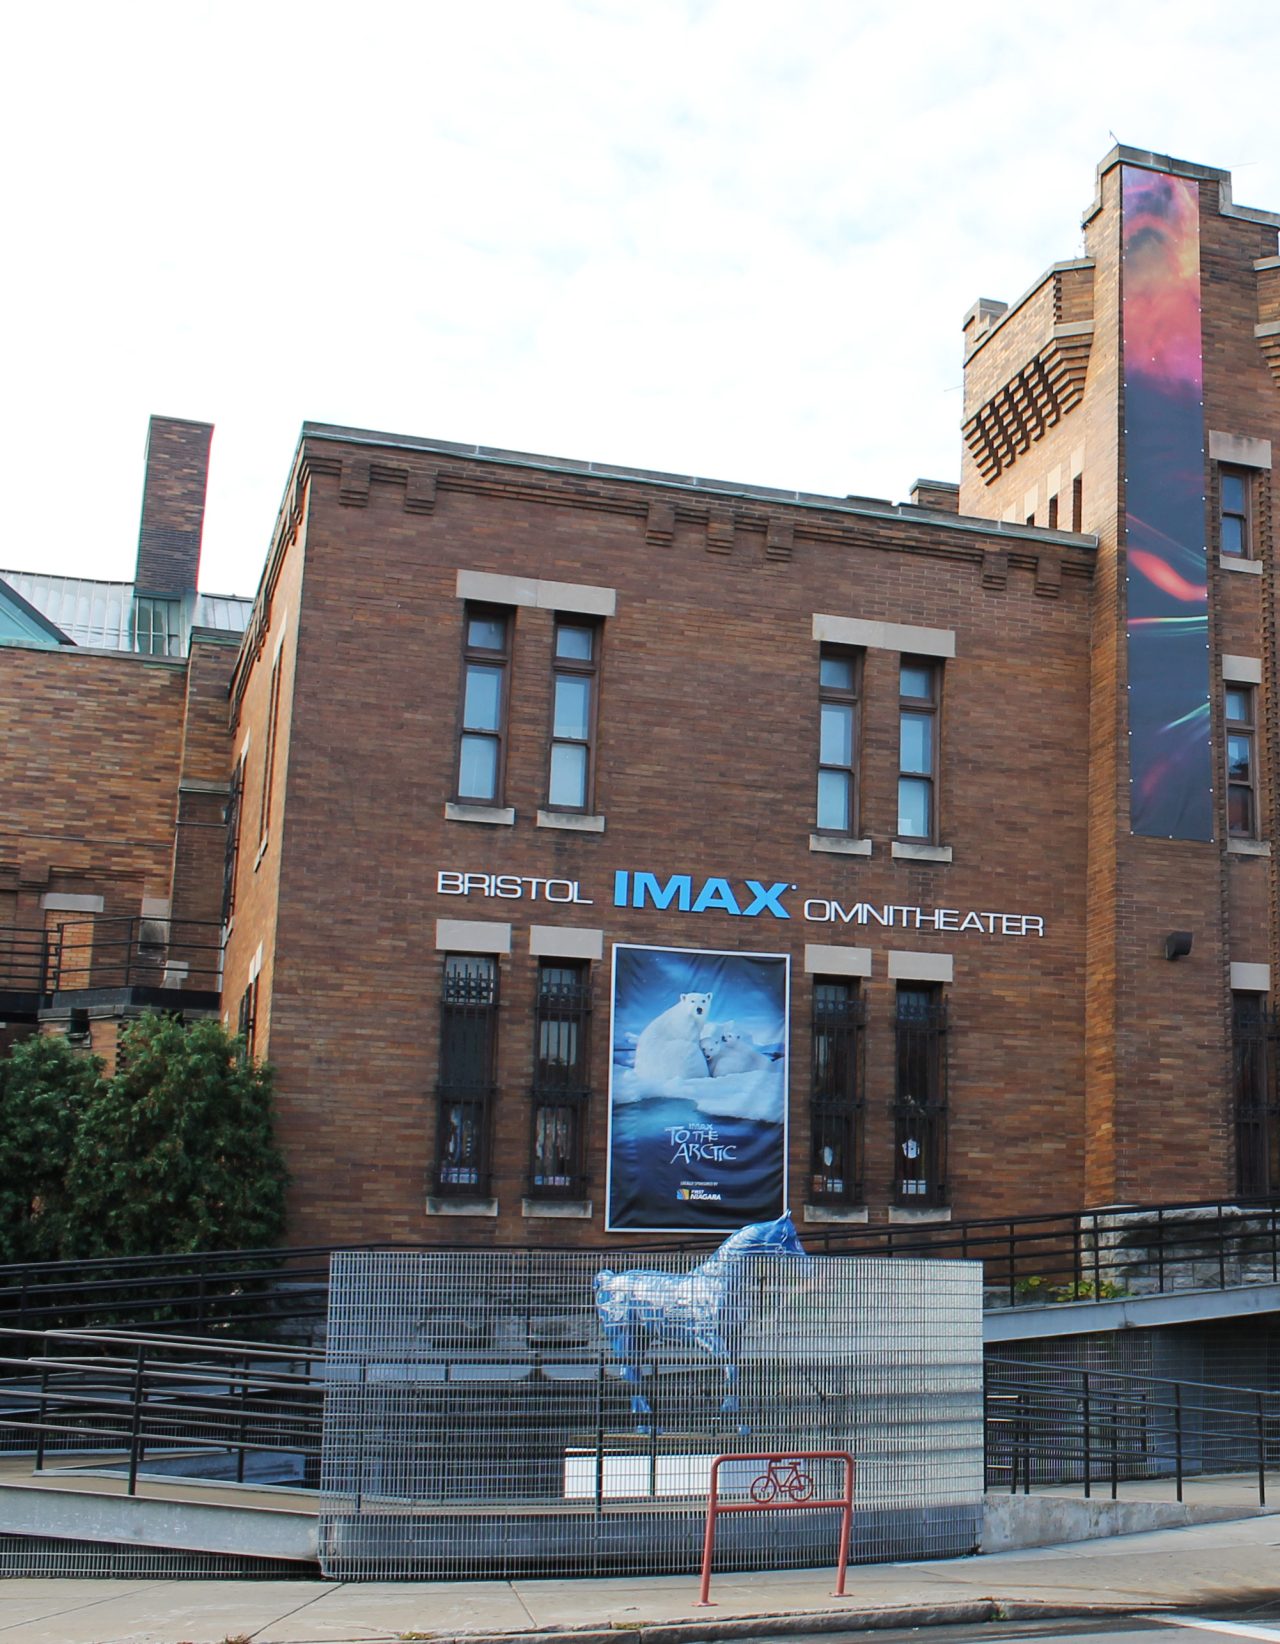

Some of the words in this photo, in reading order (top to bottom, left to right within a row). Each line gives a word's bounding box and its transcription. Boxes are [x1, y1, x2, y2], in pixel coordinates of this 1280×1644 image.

[436, 870, 594, 905] BRISTOL
[613, 870, 791, 919] IMAX
[803, 898, 1044, 937] OMNITHEATER
[664, 1126, 690, 1146] TO
[692, 1130, 719, 1143] THE
[670, 1143, 737, 1164] ARCTIC
[690, 1193, 721, 1201] NIAGARA
